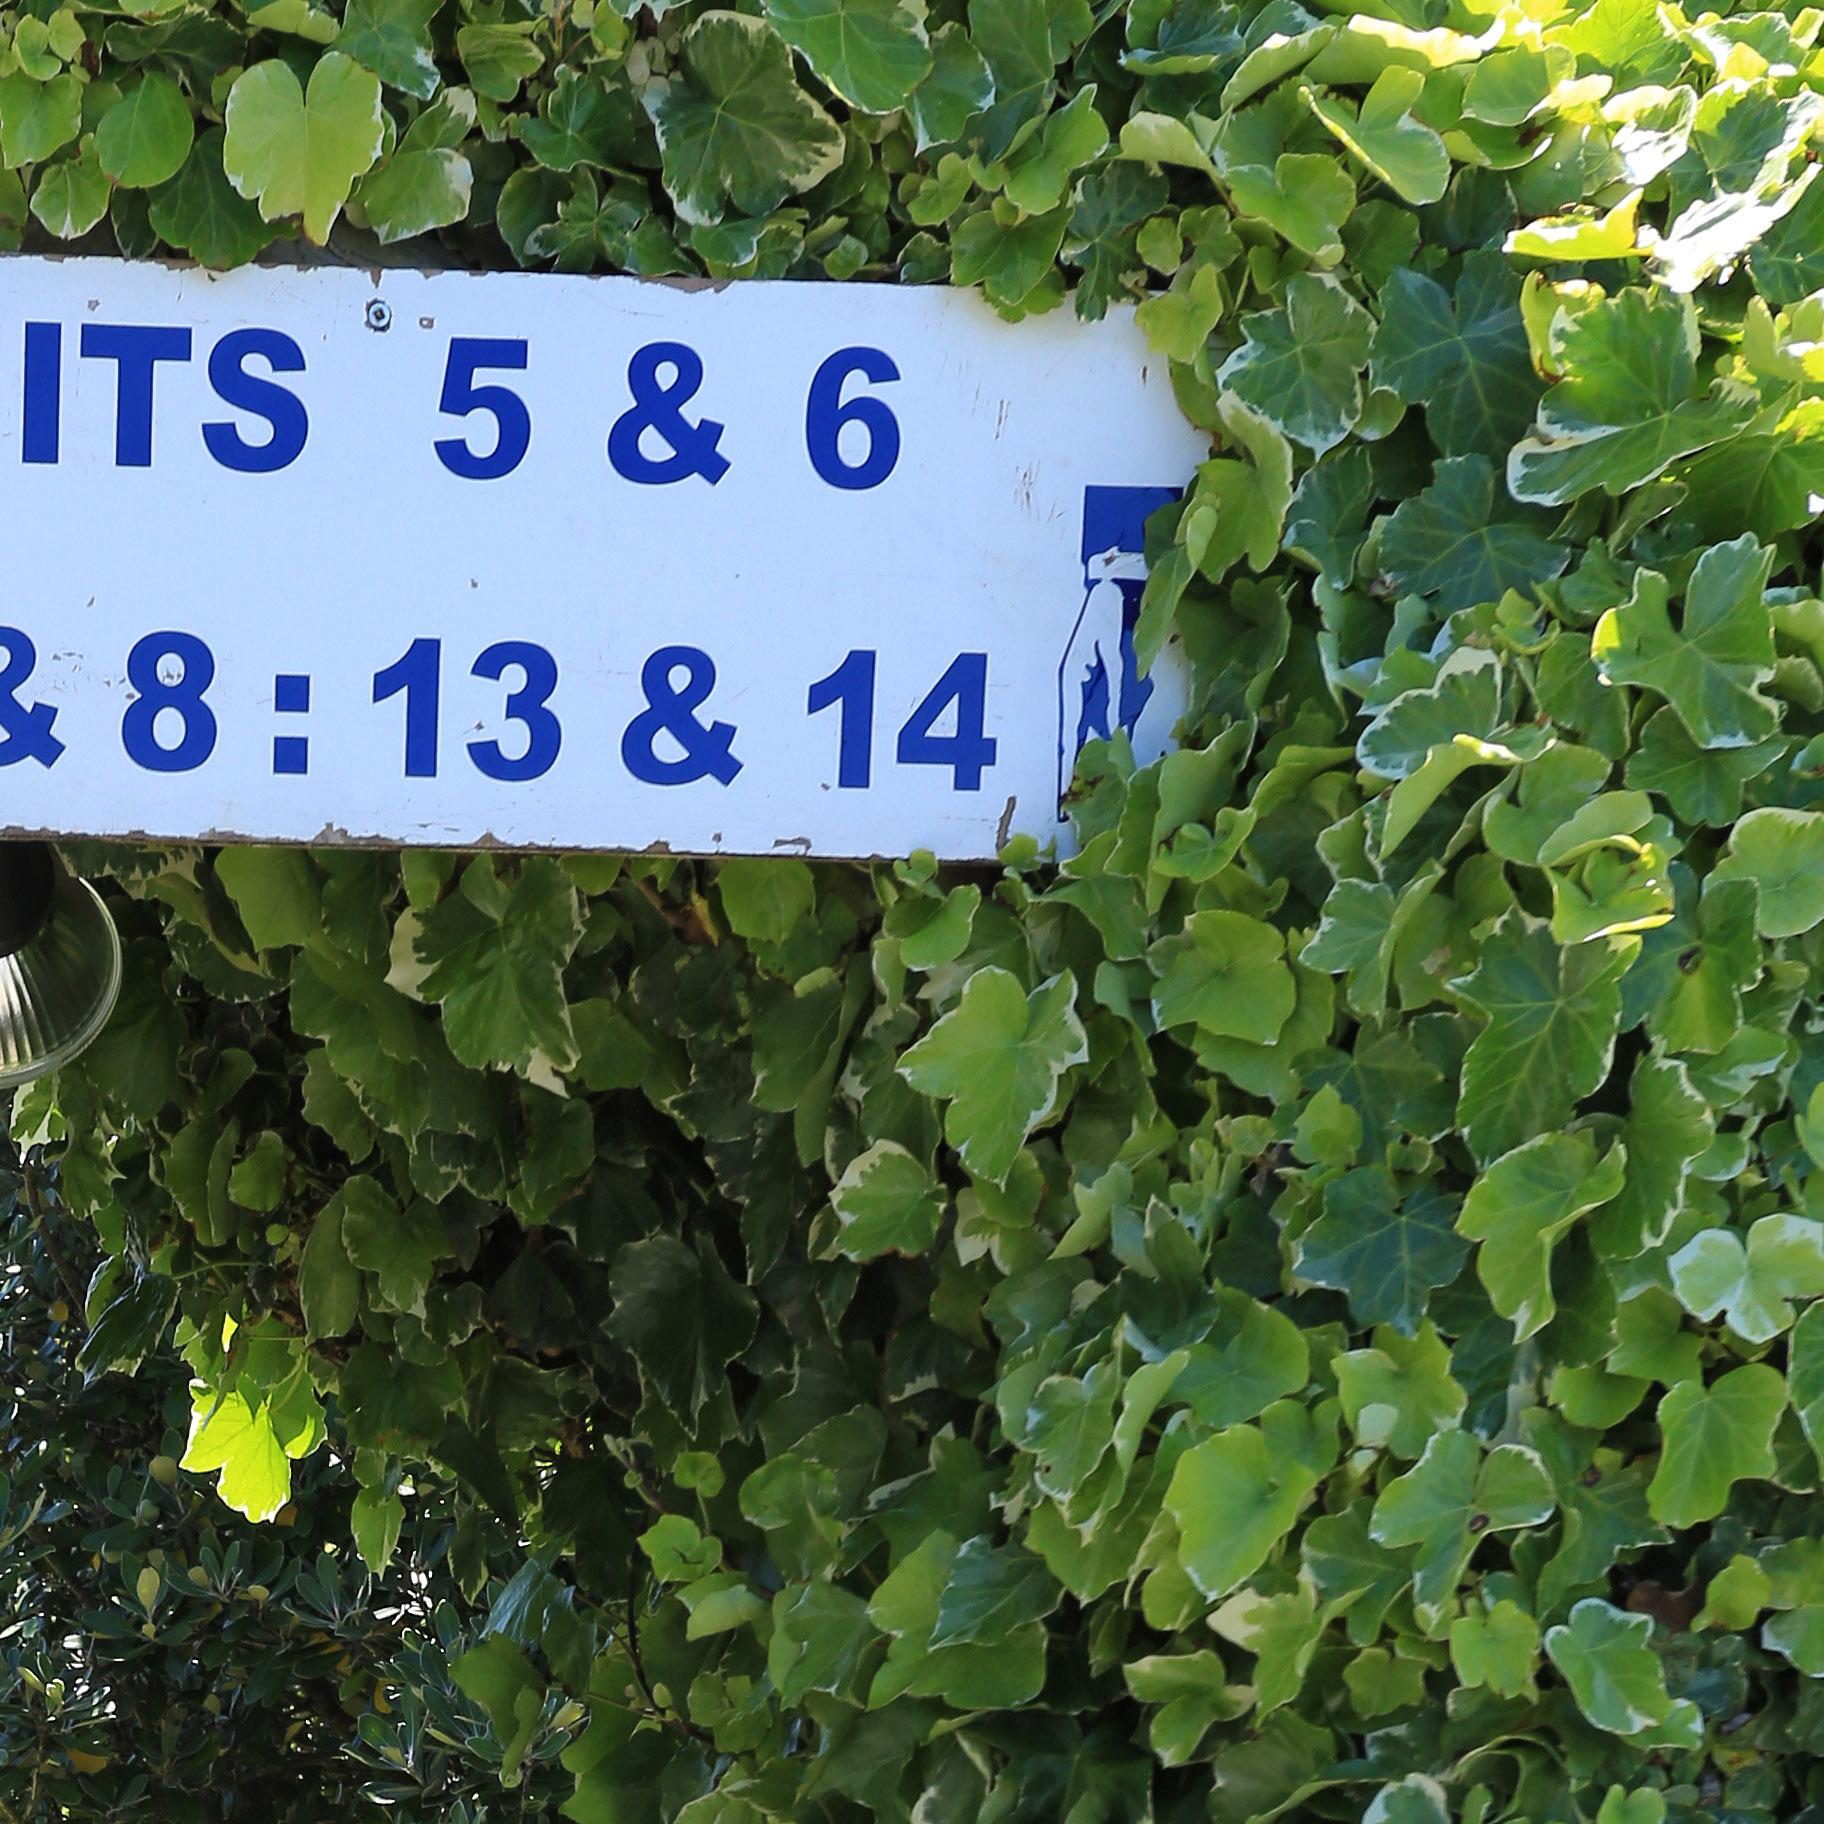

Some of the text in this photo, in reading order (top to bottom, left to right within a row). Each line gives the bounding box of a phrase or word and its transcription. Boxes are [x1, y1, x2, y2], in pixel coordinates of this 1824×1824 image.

[433, 337, 533, 482] 5
[607, 341, 732, 486] &
[805, 346, 901, 491] 6
[372, 637, 562, 783] 13
[620, 645, 744, 787] &
[807, 649, 998, 792] 14
